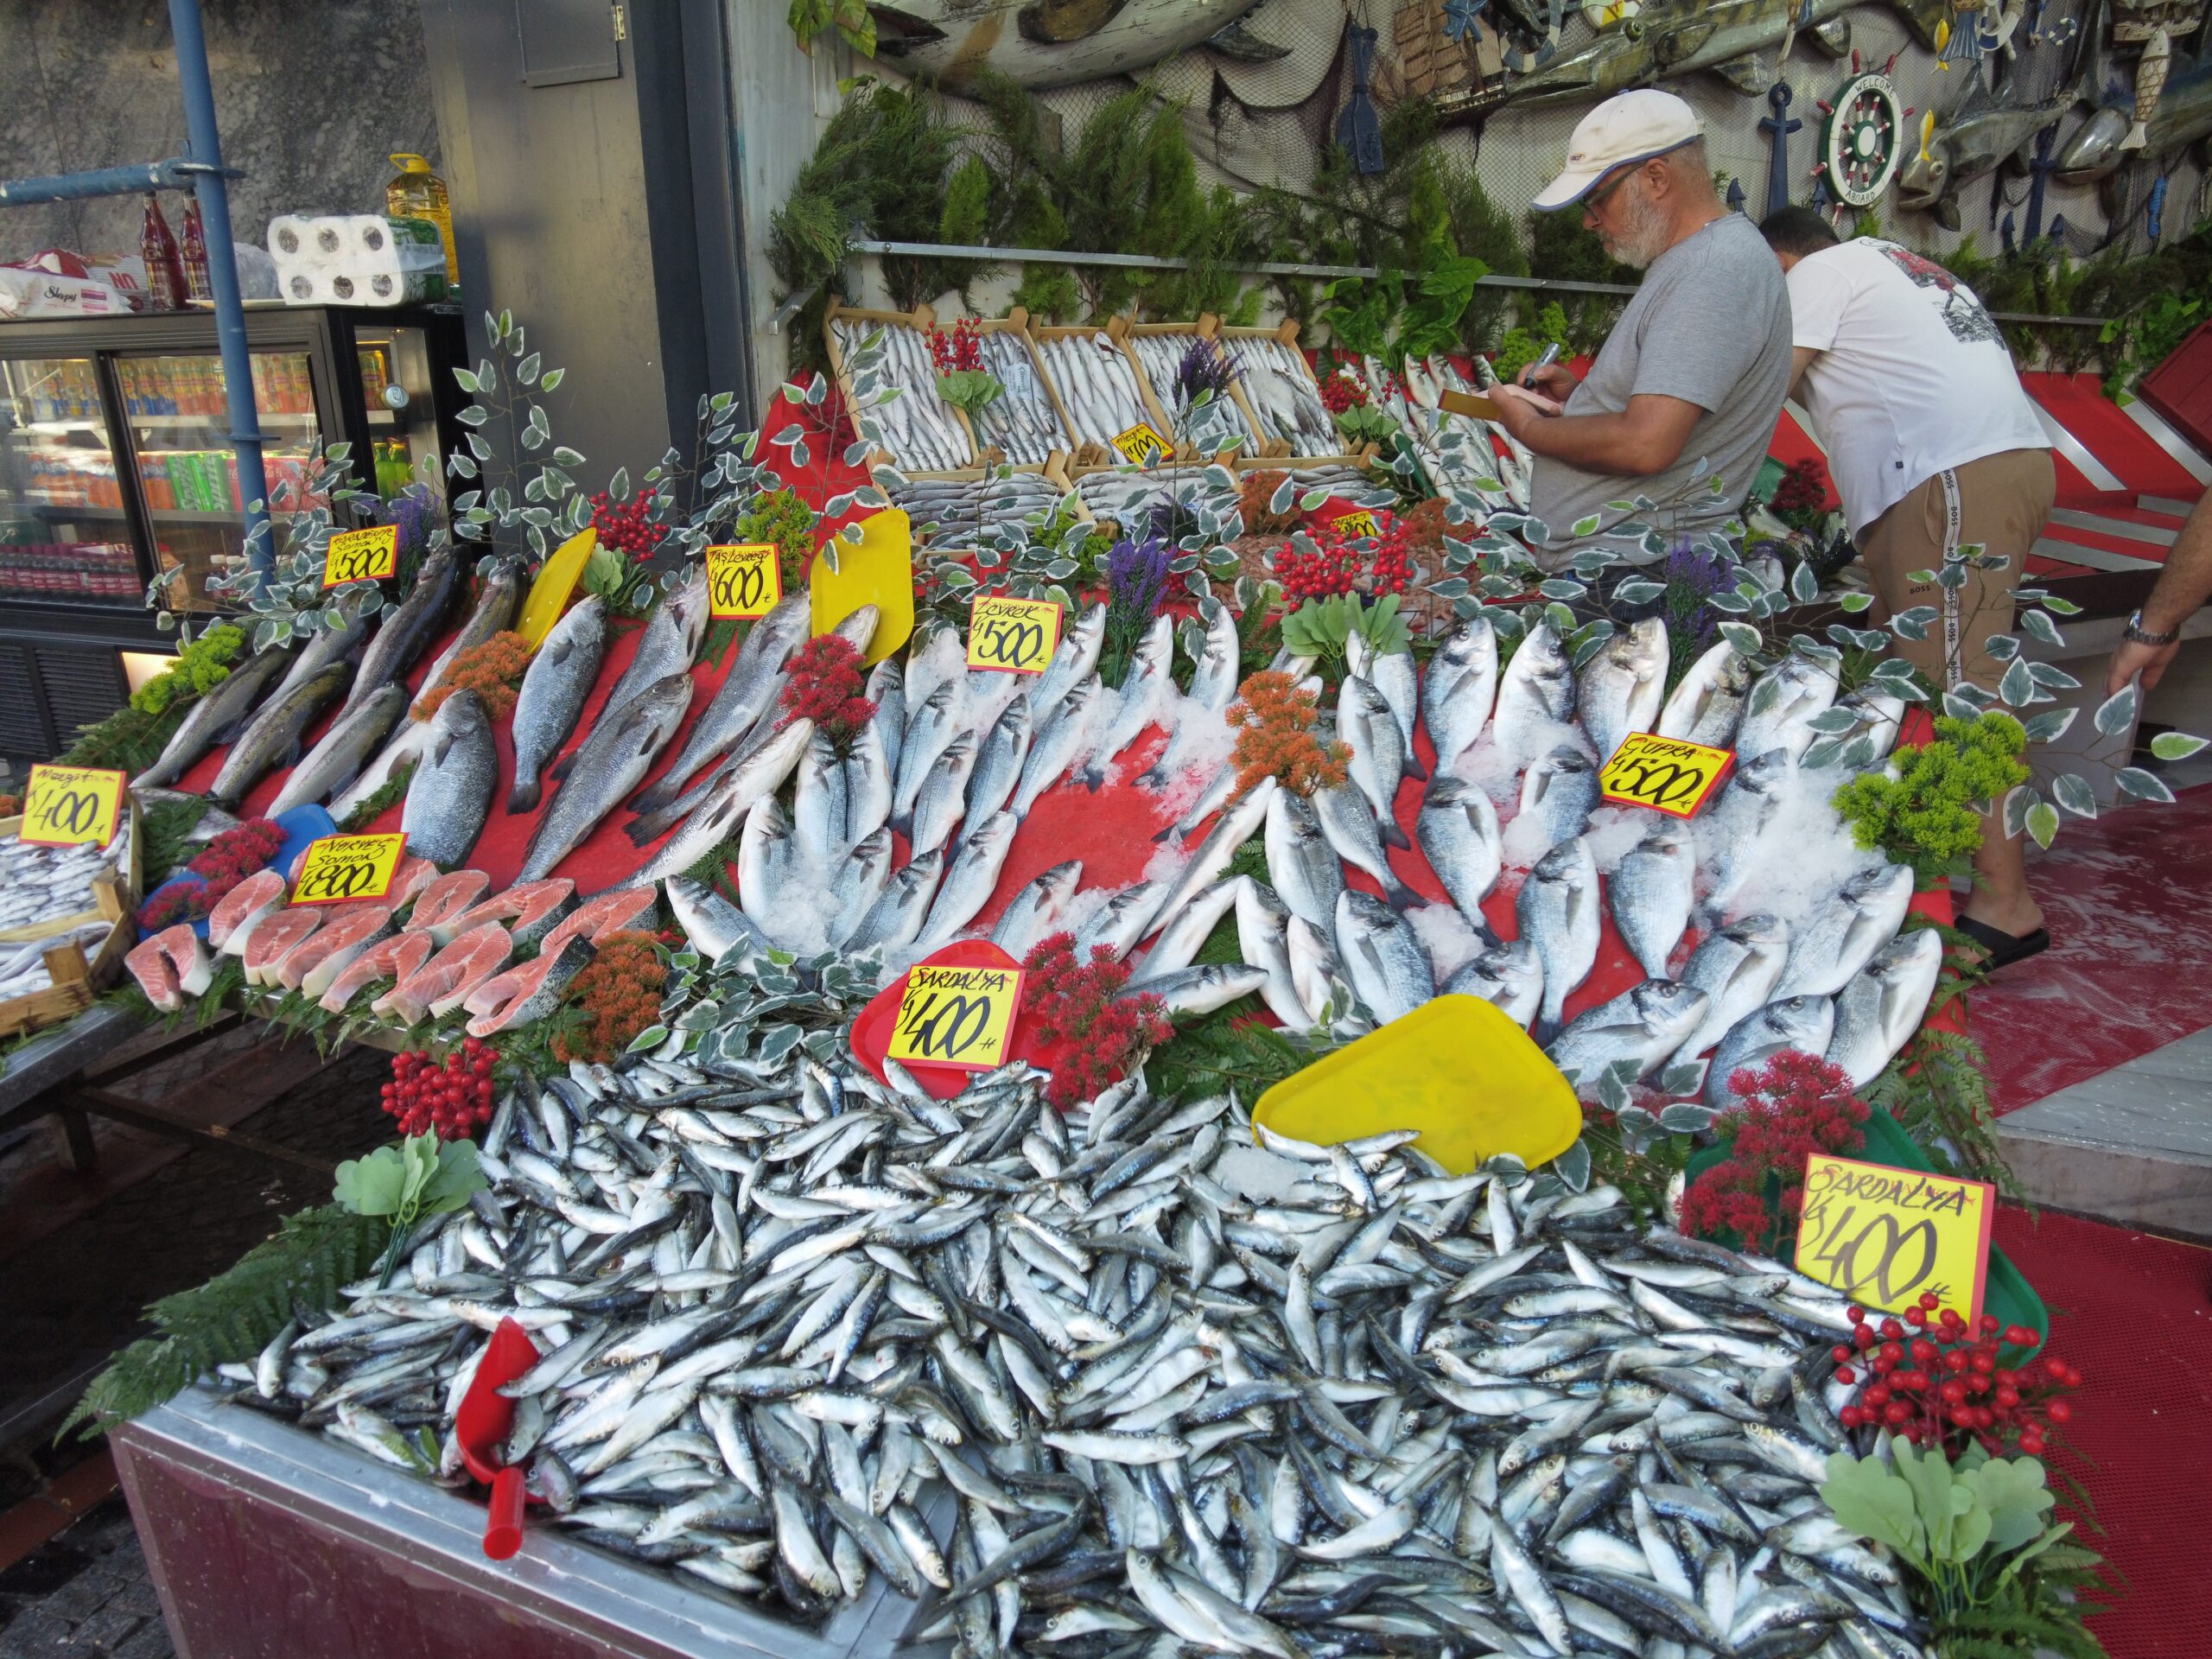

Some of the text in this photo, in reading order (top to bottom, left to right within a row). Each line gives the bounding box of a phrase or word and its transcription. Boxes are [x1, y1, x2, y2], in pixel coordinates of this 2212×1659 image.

[1855, 78, 1895, 99] WELCOME
[1845, 189, 1875, 206] ABOARD
[44, 286, 76, 302] Sleepy
[335, 546, 388, 580] 500
[715, 566, 764, 609] 600
[1910, 585, 1931, 594] BOSS
[977, 620, 1043, 667] 500
[1610, 758, 1704, 804] 500
[34, 789, 99, 836] 400
[303, 862, 375, 897] 800
[907, 967, 1005, 992] SARDALYA
[903, 993, 991, 1058] 400
[1807, 1164, 1966, 1217] SARDALYA
[1811, 1205, 1937, 1306] 400
